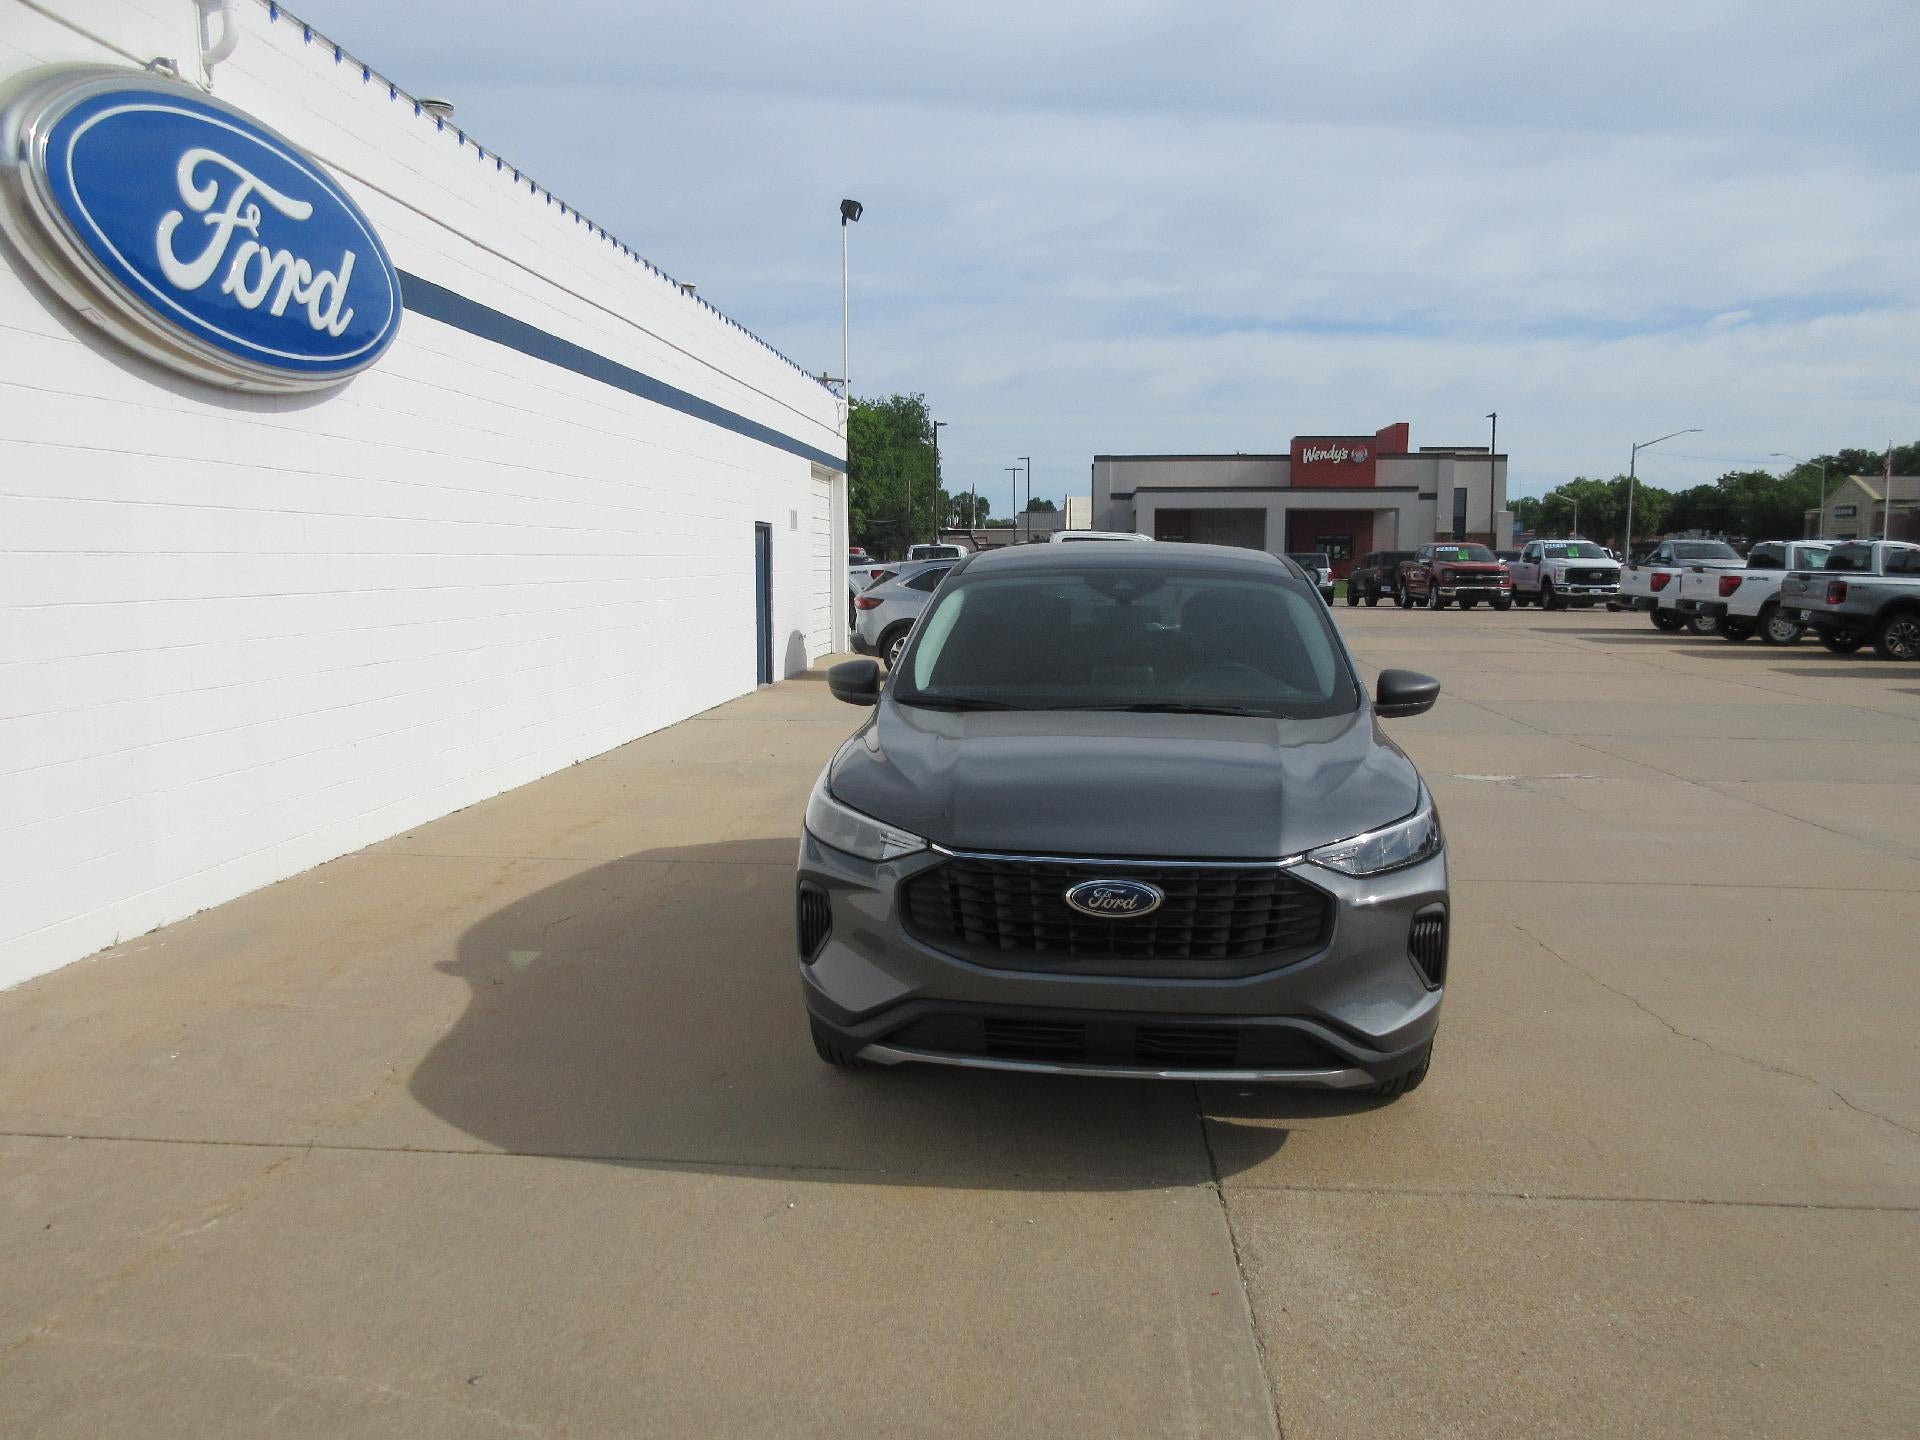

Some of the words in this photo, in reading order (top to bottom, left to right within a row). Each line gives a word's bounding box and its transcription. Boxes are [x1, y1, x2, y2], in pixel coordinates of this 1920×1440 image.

[156, 148, 357, 338] Ford
[1302, 444, 1349, 464] Wendy's
[1088, 887, 1139, 910] Ford
